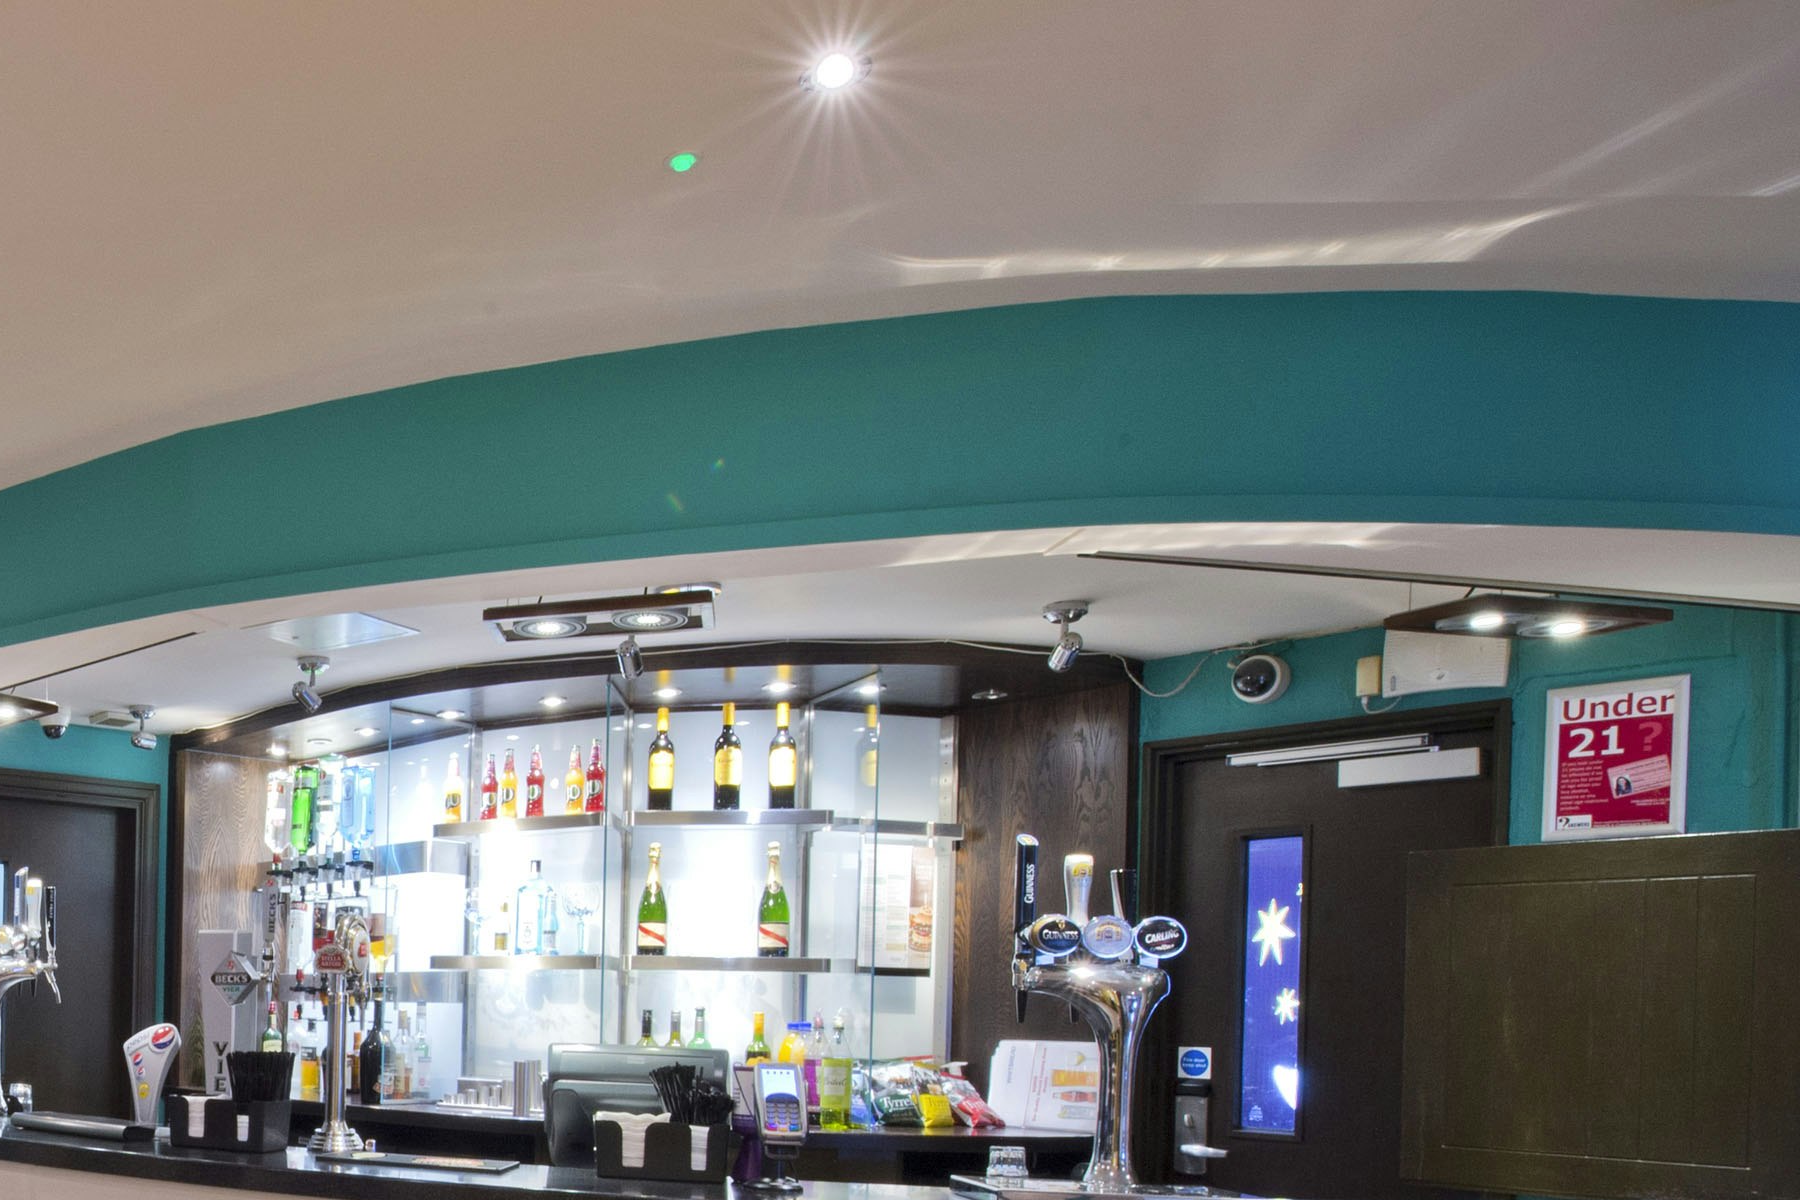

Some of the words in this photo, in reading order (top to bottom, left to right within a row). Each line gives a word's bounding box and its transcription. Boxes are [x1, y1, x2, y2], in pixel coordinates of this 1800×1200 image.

[1562, 692, 1676, 722] Under
[1567, 724, 1625, 759] 21
[1024, 863, 1035, 904] GUINNESS
[1042, 928, 1079, 941] GUINNESS
[1144, 929, 1180, 944] CARLING
[212, 1041, 229, 1092] VIE
[882, 1094, 913, 1112] Tyrrel
